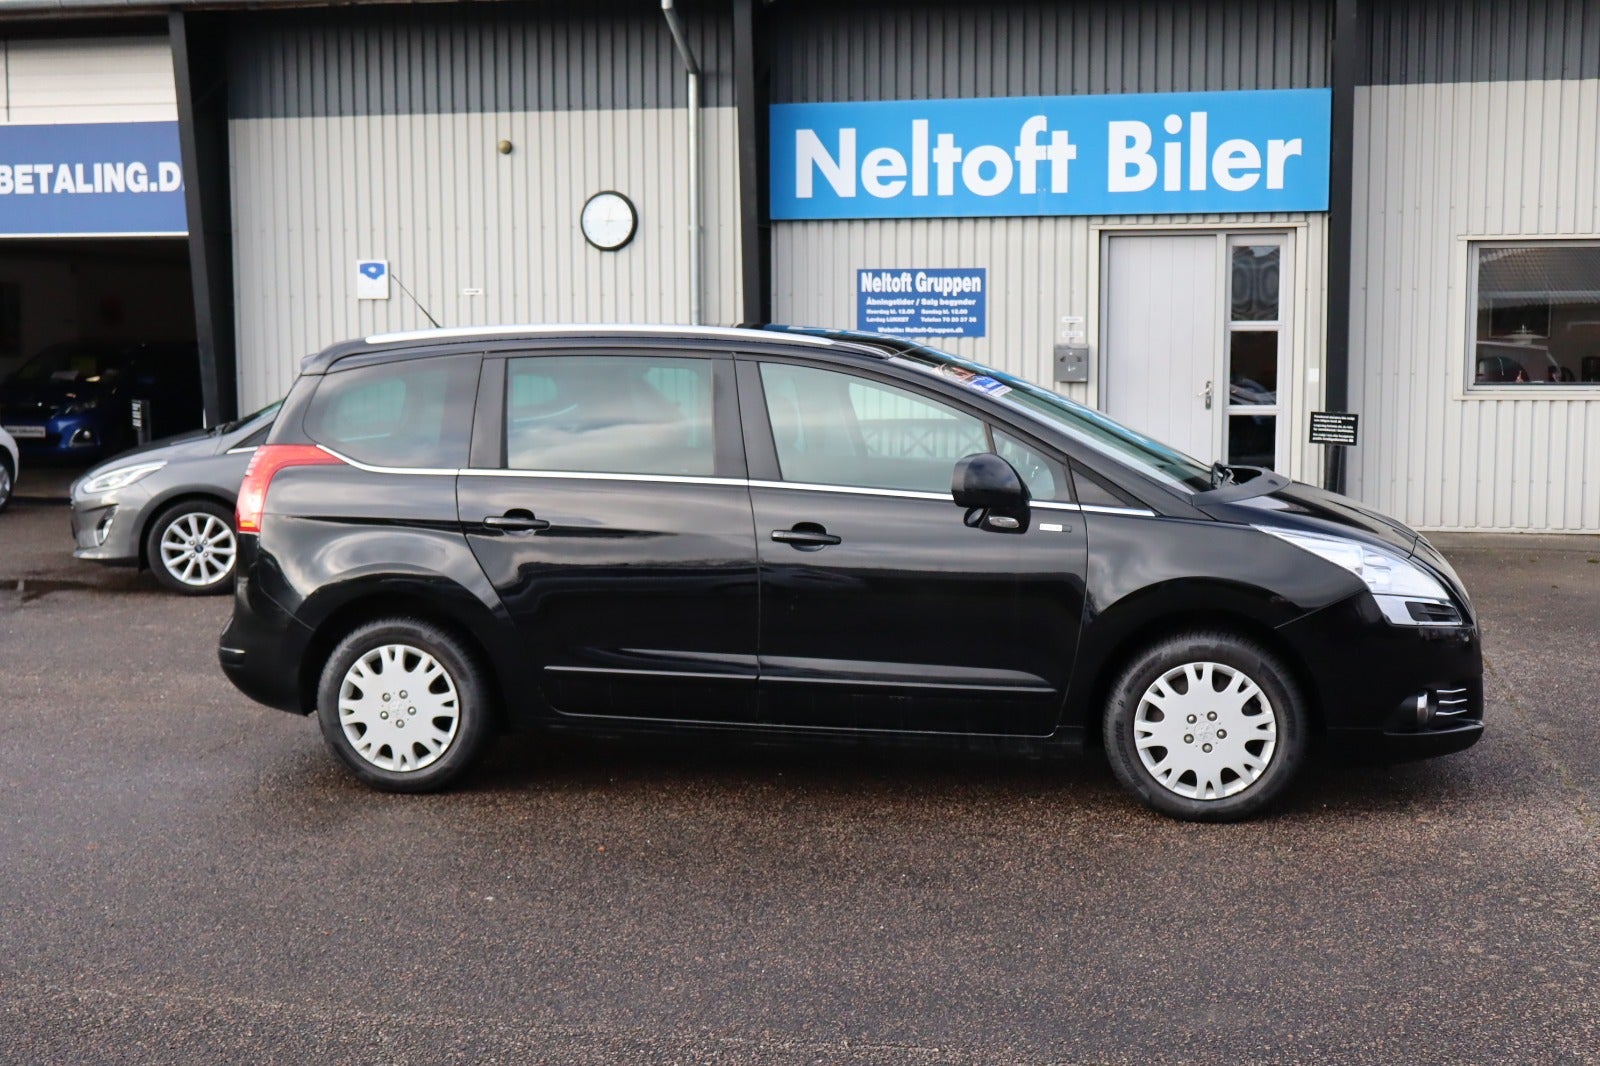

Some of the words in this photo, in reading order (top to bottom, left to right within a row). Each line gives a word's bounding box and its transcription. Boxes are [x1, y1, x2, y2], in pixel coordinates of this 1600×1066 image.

[796, 115, 1077, 198] Neltoft
[1107, 111, 1302, 193] Biler
[0, 161, 185, 195] BETALING.D
[861, 272, 912, 293] Neltoft
[915, 271, 981, 297] Gruppen
[866, 296, 914, 307] Åbningstider
[921, 298, 939, 307] Salg
[939, 298, 976, 307] begynder
